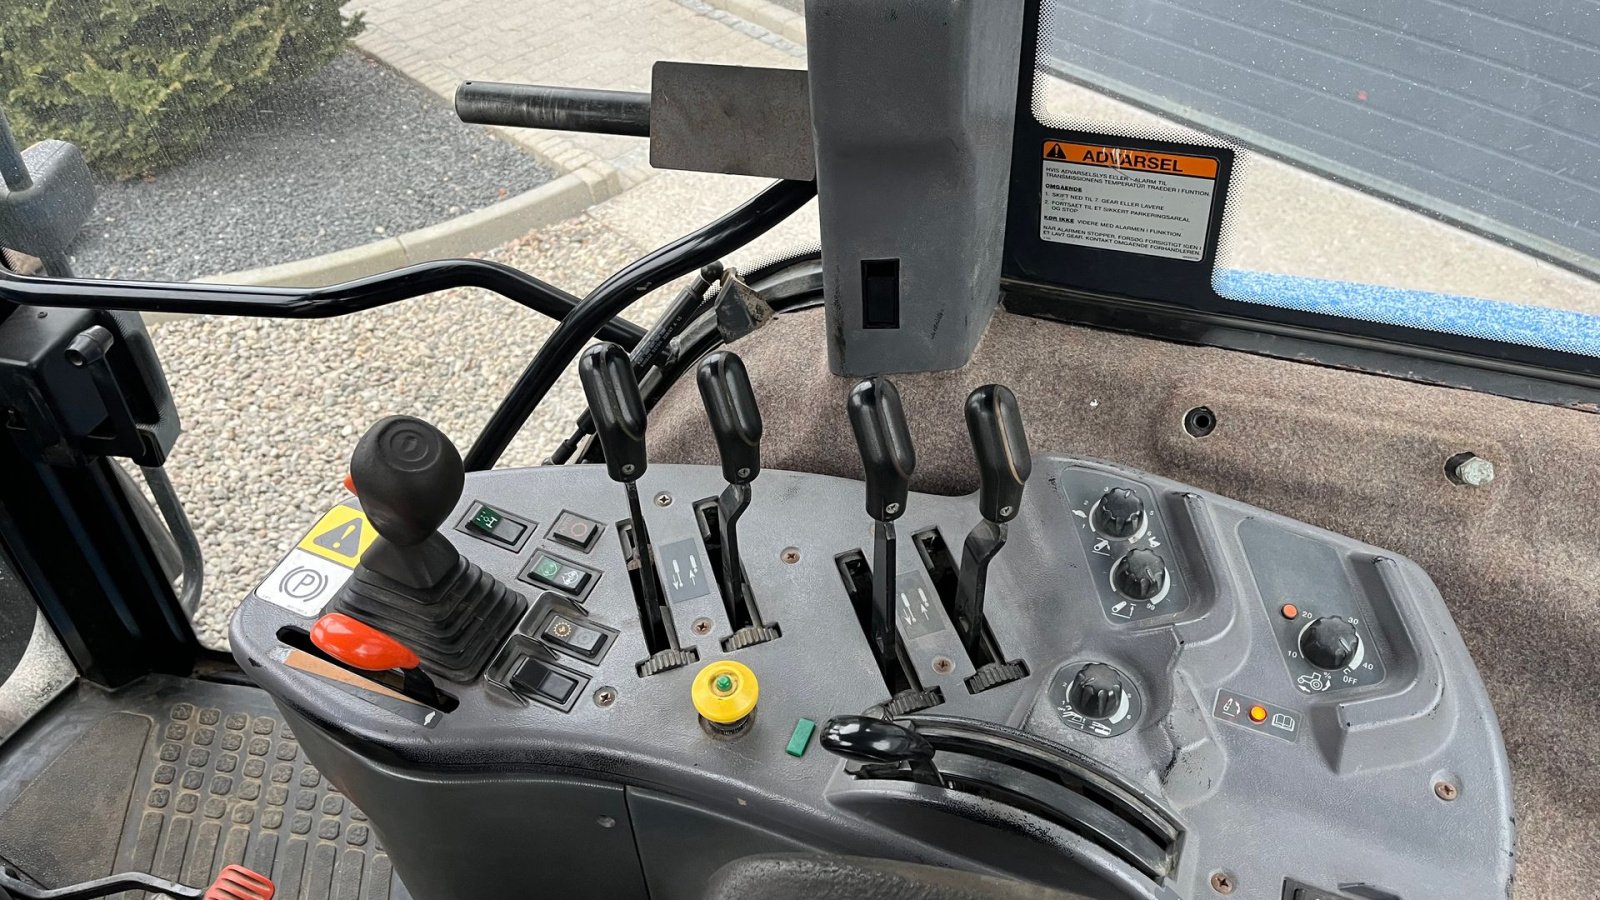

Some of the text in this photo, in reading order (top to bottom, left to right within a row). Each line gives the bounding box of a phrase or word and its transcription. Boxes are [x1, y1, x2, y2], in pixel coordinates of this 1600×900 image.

[1082, 150, 1183, 172] ADVARSEL
[1045, 172, 1103, 184] TRANSMISSIONENS
[1140, 203, 1164, 211] LAVERE
[1130, 210, 1190, 223] PARKERINGSAREAL
[1057, 226, 1086, 235] ALARMEN
[1077, 219, 1099, 227] VIDERE
[1115, 224, 1145, 233] ALARMEN
[1085, 236, 1113, 244] KONTAKT
[1302, 610, 1313, 619] 20
[1347, 616, 1359, 625] 30
[1287, 650, 1298, 658] 10
[1362, 662, 1374, 671] 40
[1343, 676, 1358, 685] OFF
